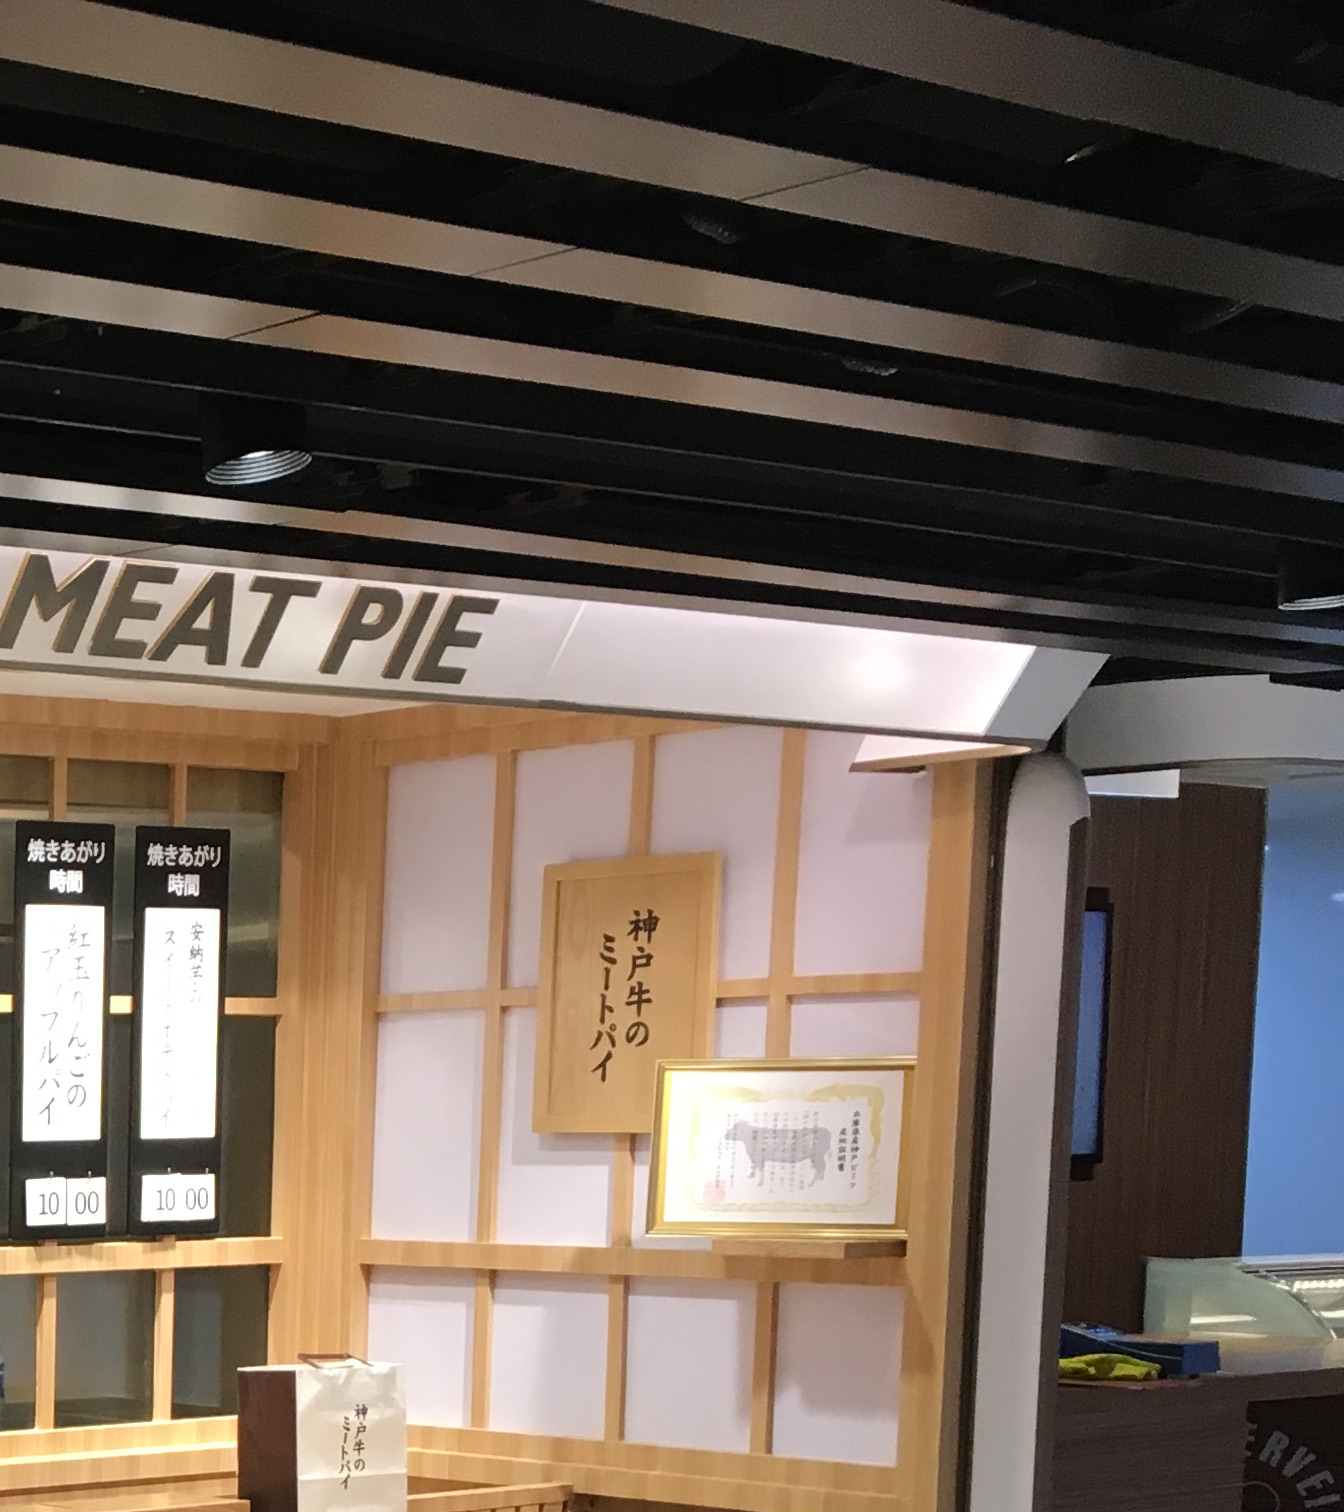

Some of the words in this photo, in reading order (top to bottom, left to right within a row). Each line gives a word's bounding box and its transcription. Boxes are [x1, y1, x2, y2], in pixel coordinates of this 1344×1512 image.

[319, 583, 500, 684] PIE
[27, 838, 106, 864] 焼きあがり
[147, 843, 222, 867] 焼きあがり
[49, 869, 83, 893] 時間
[167, 873, 200, 896] 時間
[624, 909, 660, 1048] 神戸牛の
[588, 933, 617, 1083] ミートパイ
[38, 1192, 60, 1215] 10
[75, 1191, 100, 1214] 00
[155, 1188, 175, 1211] 10
[185, 1187, 209, 1210] 00
[339, 1416, 351, 1489] ミートパイ
